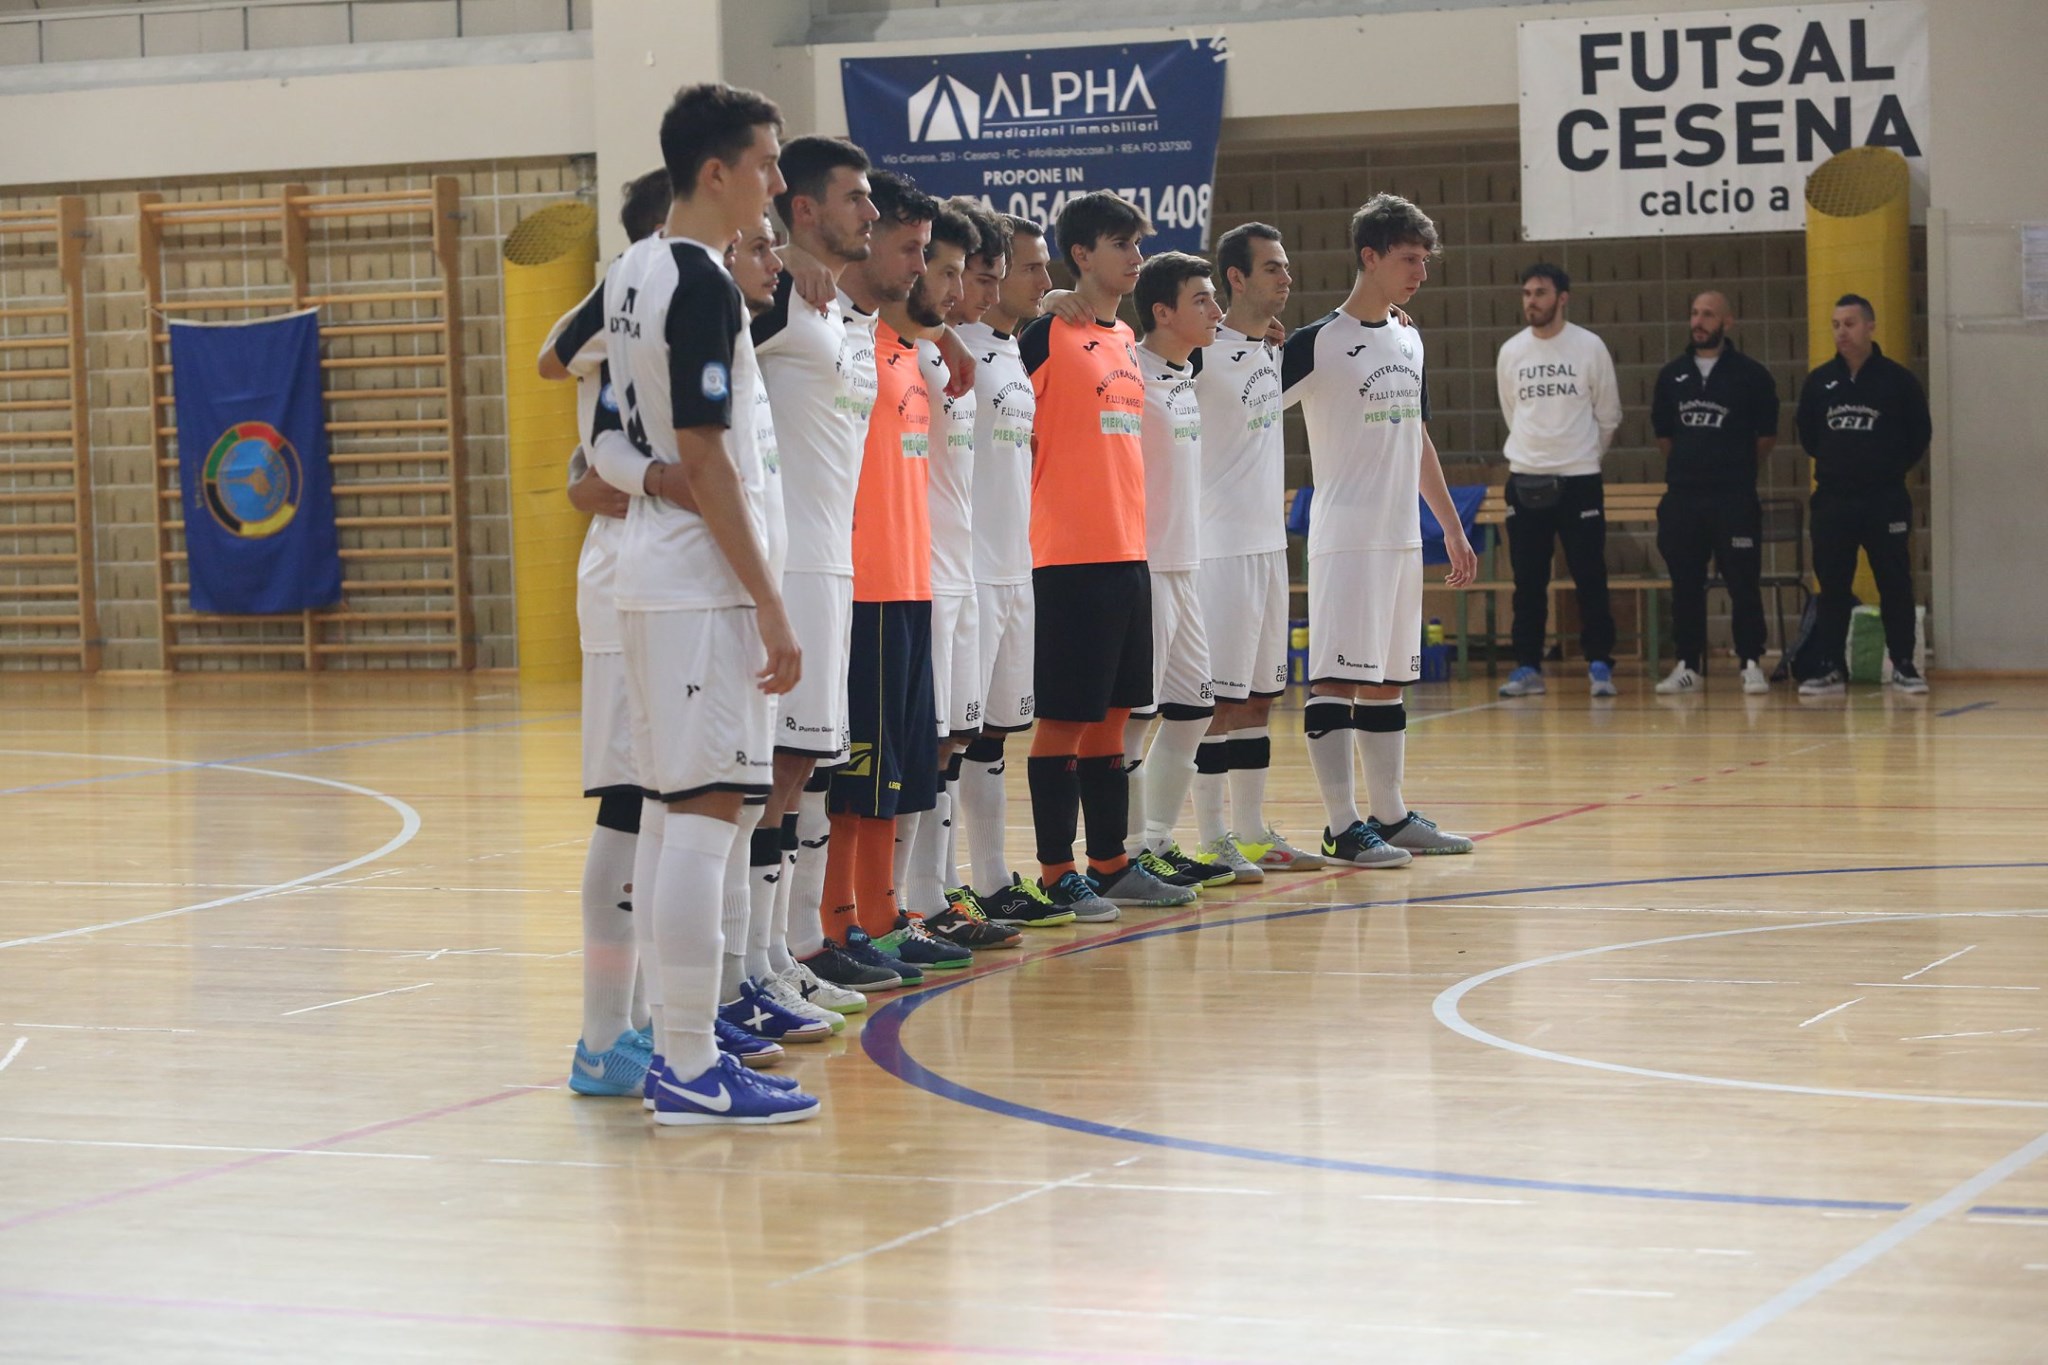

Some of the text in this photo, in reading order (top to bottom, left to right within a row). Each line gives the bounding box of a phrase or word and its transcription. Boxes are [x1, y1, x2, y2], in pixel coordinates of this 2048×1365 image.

[1579, 18, 1895, 96] FUTSAL
[984, 63, 1157, 119] ALPHA
[981, 119, 1159, 141] mediazioni immobiliari
[1557, 94, 1922, 172] CESENA
[982, 167, 1085, 187] PROPONE IN
[1640, 180, 1790, 217] calcio a
[1518, 364, 1577, 381] FUTSAL
[1518, 383, 1578, 400] CESENA
